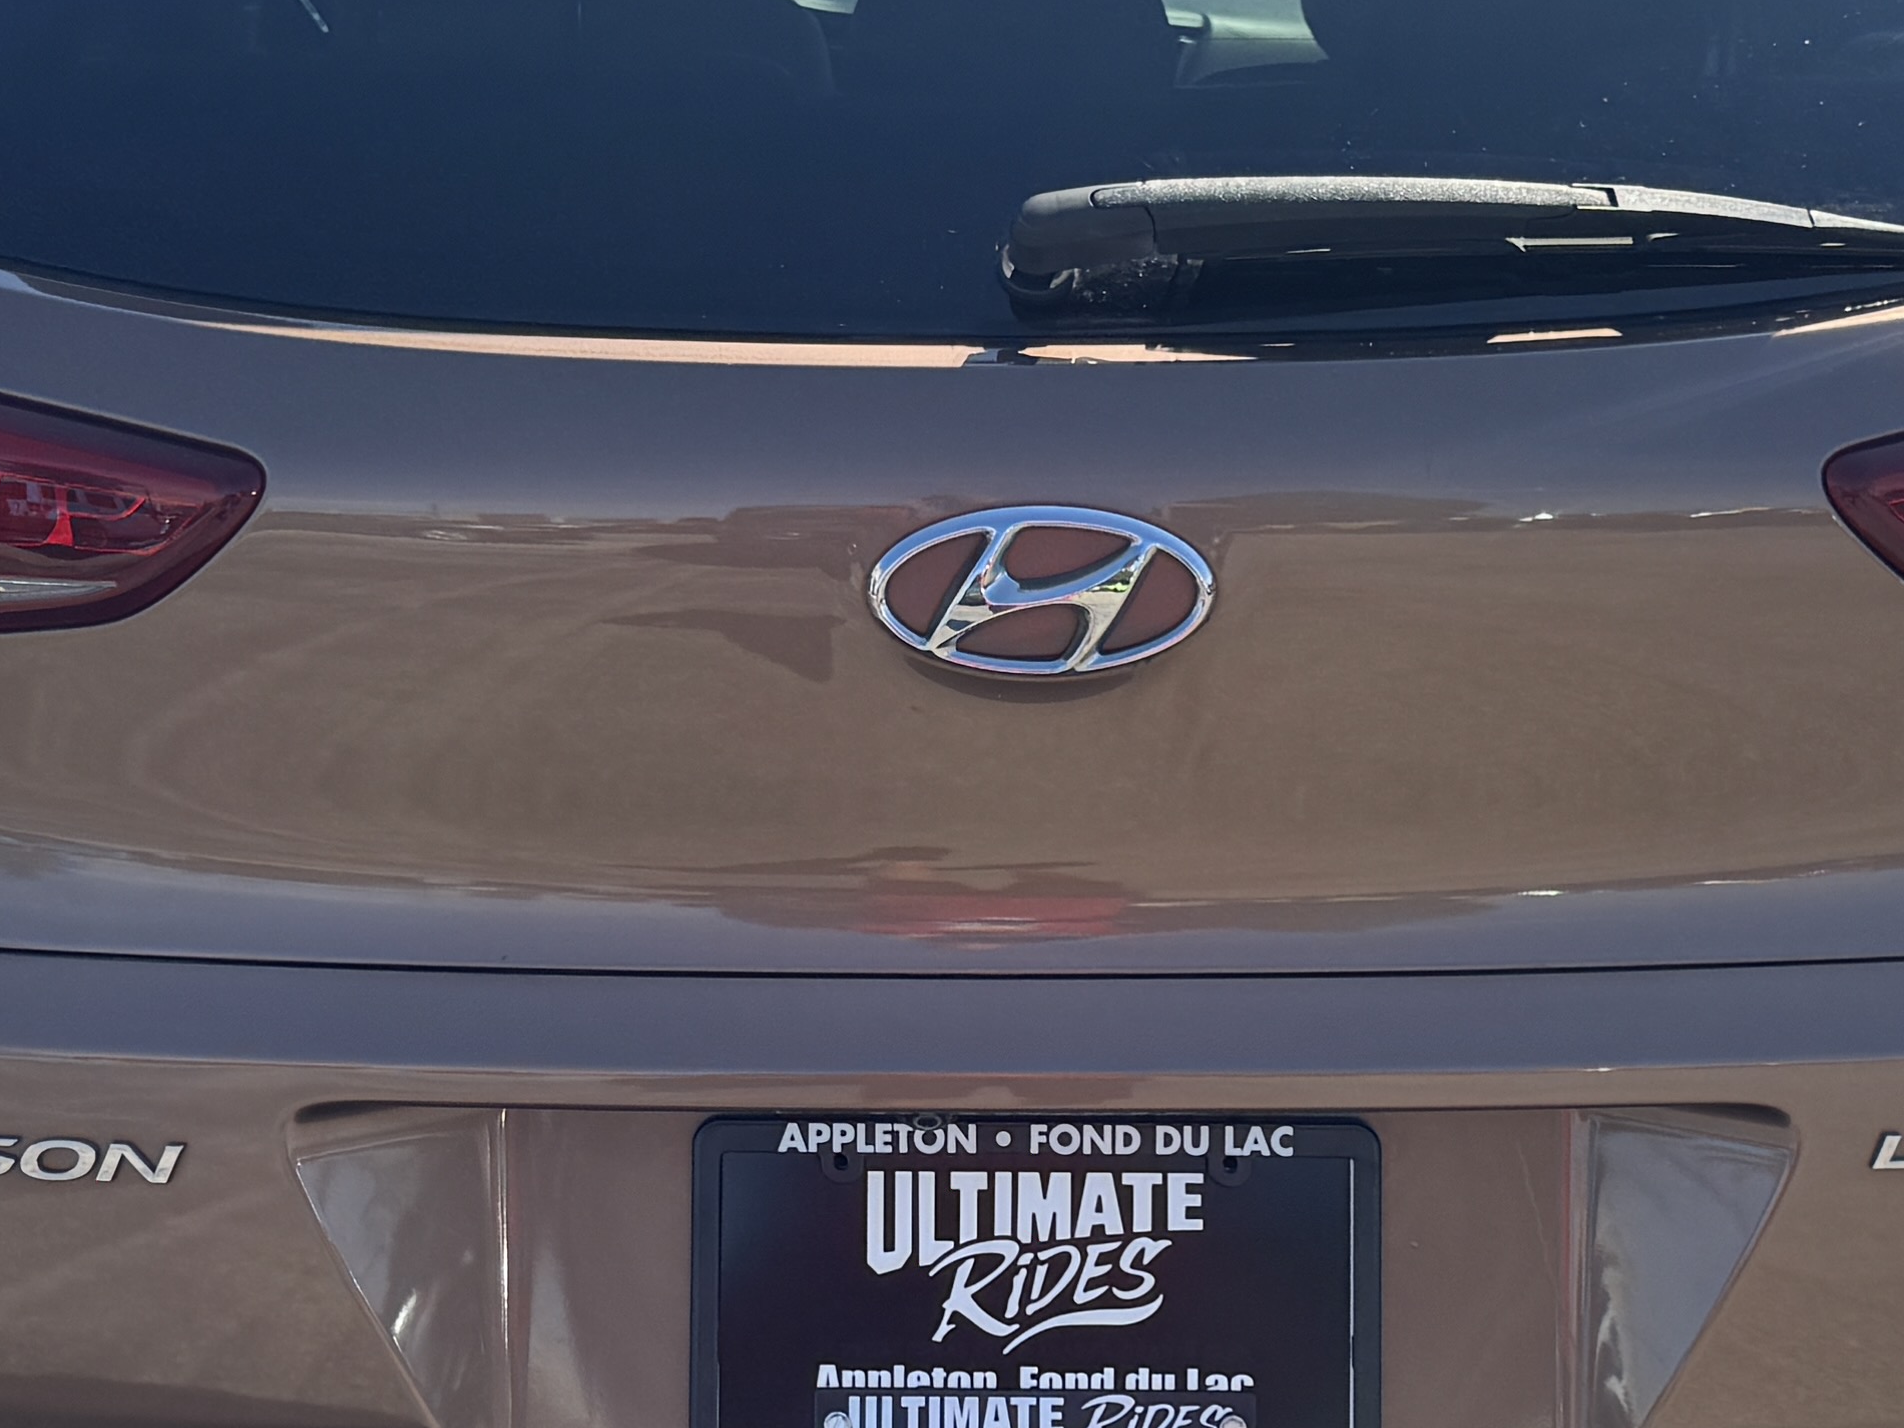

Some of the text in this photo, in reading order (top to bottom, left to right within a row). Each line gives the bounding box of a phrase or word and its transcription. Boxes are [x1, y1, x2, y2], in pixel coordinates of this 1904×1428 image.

[777, 1122, 1295, 1158] APPLETON FOND DU LAC
[866, 1170, 1205, 1276] ULTIMATE
